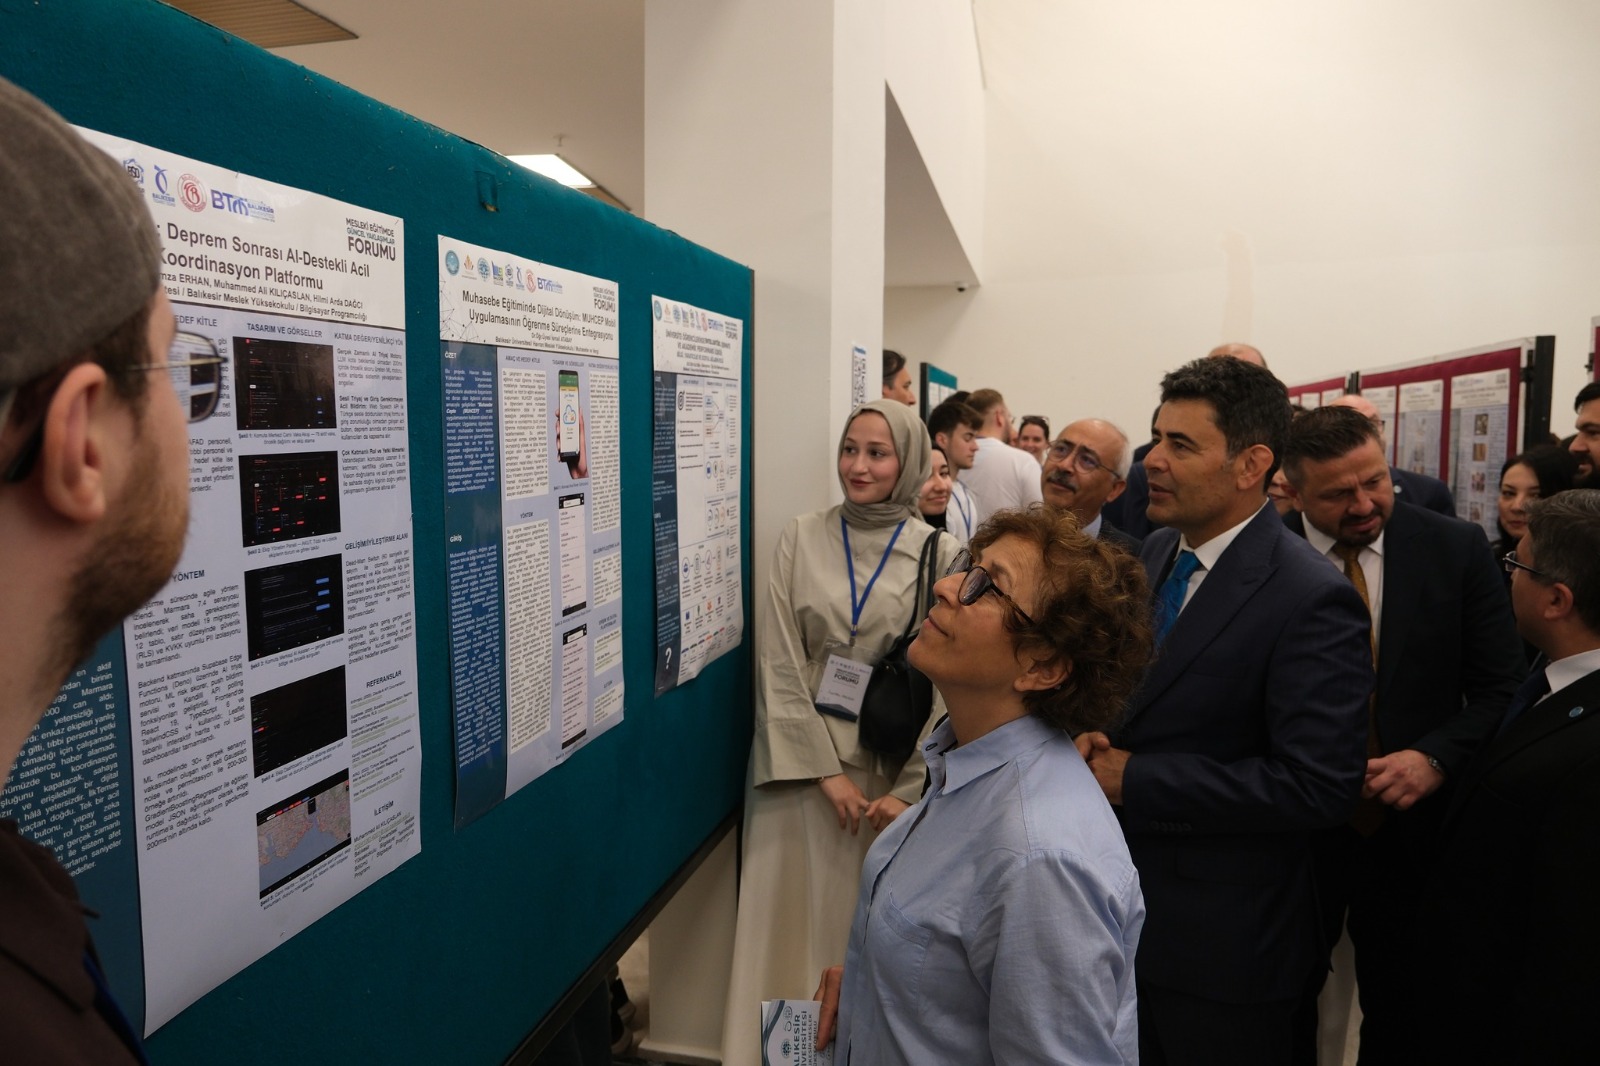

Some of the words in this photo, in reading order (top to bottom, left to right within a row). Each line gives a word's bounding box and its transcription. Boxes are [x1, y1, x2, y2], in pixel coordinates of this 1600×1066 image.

[346, 218, 369, 230] MESLEKİ
[347, 228, 365, 237] GÜNCEL
[168, 223, 227, 249] Deprem
[232, 236, 283, 260] Sonrası
[351, 262, 370, 277] Acil
[348, 236, 396, 261] FORUMU
[180, 274, 212, 288] ERHAN,
[214, 280, 256, 294] Muhammed
[258, 286, 267, 294] Ali
[265, 266, 323, 290] Platformu
[224, 293, 249, 305] Meslek
[252, 298, 294, 310] Yüksekokulu
[300, 304, 330, 316] Bilgisayar
[462, 290, 500, 307] Muhasebe
[502, 298, 536, 313] Eğitiminde
[594, 298, 616, 312] FORUMU
[175, 315, 194, 324] EDEF
[197, 316, 217, 326] KİTLE
[469, 309, 520, 326] Uygulamasının
[523, 315, 550, 331] Öğrenme
[551, 322, 581, 335] Süreçlerine
[247, 323, 276, 333] TASARIM
[288, 327, 322, 338] GÖRSELLER
[172, 570, 204, 582] YÖNTEM
[164, 604, 190, 614] Marmara
[166, 642, 183, 652] KVKK
[76, 669, 86, 677] en
[138, 676, 164, 688] Backend
[834, 674, 859, 685] FORUMU
[82, 683, 113, 696] Marmara
[139, 686, 168, 698] Functions
[73, 701, 86, 709] can
[54, 708, 93, 726] yetersizliği
[41, 727, 65, 740] enkaz
[67, 718, 93, 732] ekipleri
[94, 713, 115, 726] yanlış
[47, 737, 64, 748] tıbbi
[66, 728, 98, 745] personel
[99, 722, 116, 734] yetki
[141, 726, 159, 736] React
[142, 729, 178, 745] TailwindCSS
[22, 751, 56, 768] olmadığı
[60, 746, 73, 756] için
[51, 772, 61, 780] bu
[71, 752, 118, 773] koordinasyon
[20, 762, 56, 779] saatlerce
[61, 754, 83, 766] haber
[93, 762, 118, 776] sahaya
[22, 803, 32, 811] ve
[41, 787, 76, 804] erişilebilir
[84, 781, 93, 789] bir
[100, 770, 119, 783] dijital
[80, 801, 92, 811] Tek
[108, 790, 119, 801] acil
[24, 809, 42, 821] hâlâ
[73, 811, 94, 826] yapay
[104, 801, 120, 812] zeka
[145, 819, 164, 831] model
[169, 809, 186, 821] JSON
[63, 829, 73, 838] rol
[80, 820, 97, 832] bazlı
[104, 811, 120, 822] saha
[54, 844, 64, 852] ve
[67, 832, 91, 849] gerçek
[81, 837, 104, 852] sistem
[108, 830, 121, 840] afet
[91, 840, 121, 858] saniyeler
